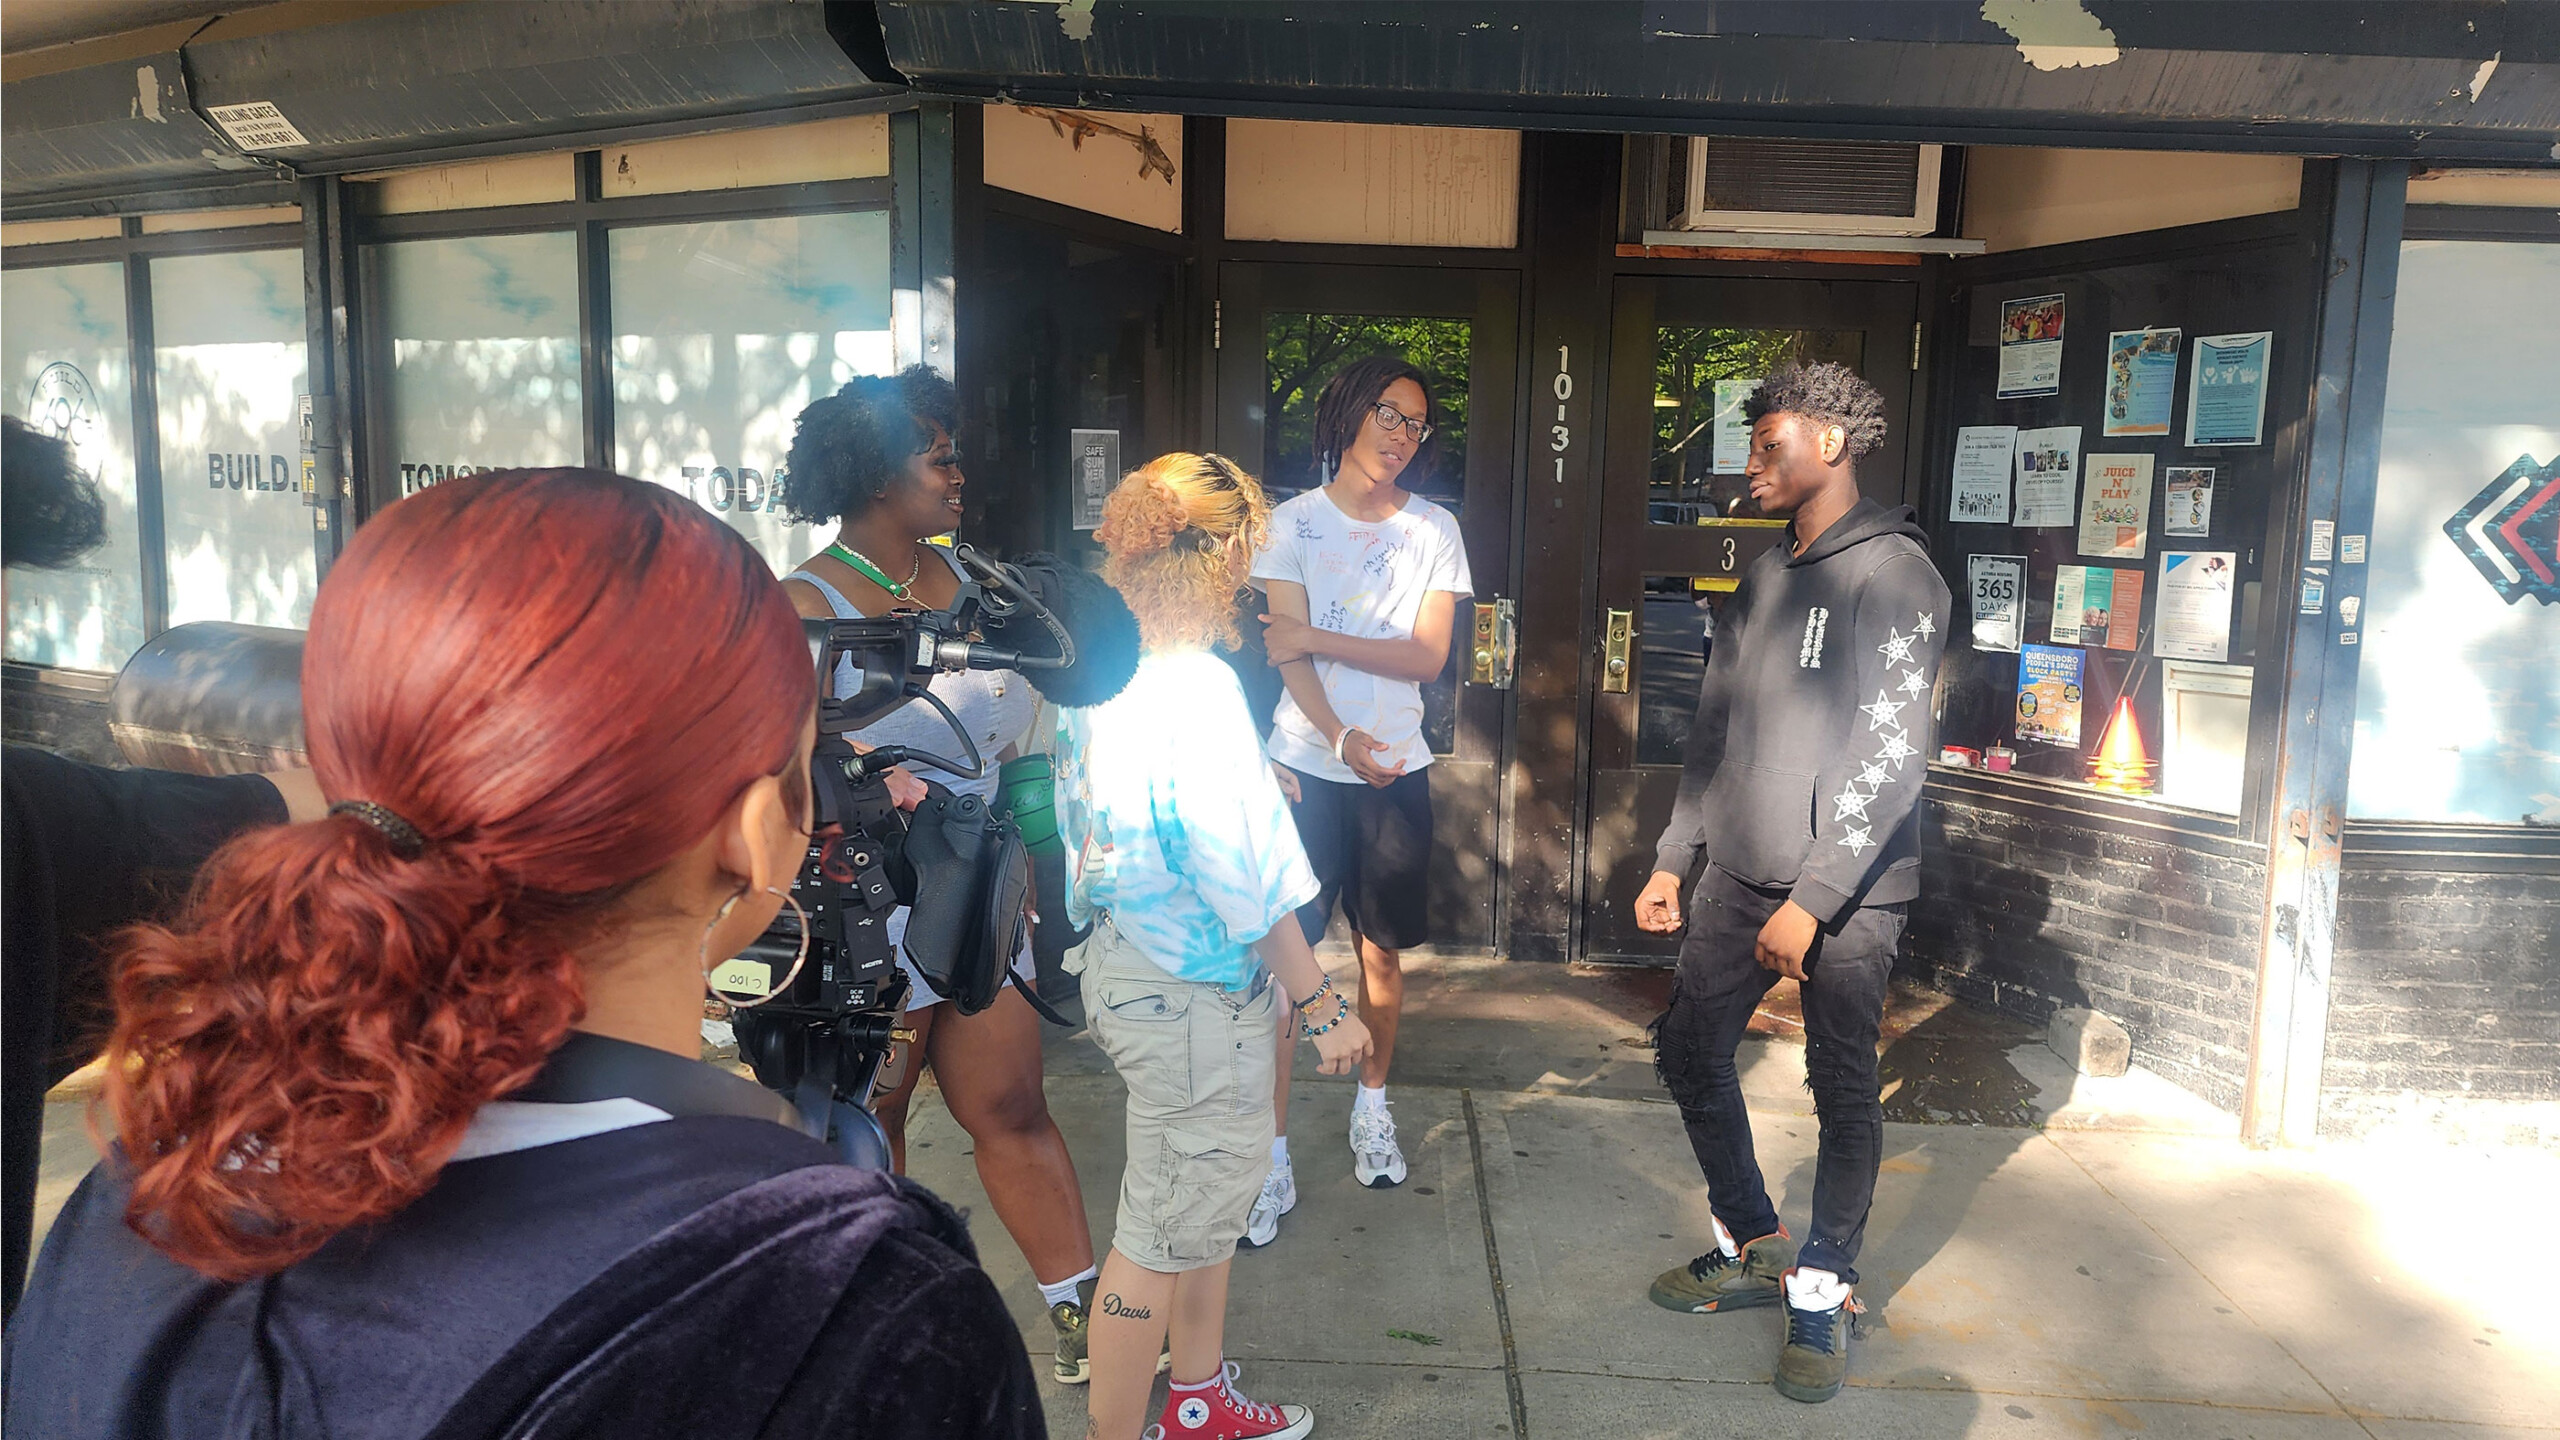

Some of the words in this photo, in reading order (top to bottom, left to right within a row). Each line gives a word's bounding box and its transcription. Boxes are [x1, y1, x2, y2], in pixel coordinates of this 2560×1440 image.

[213, 107, 251, 124] ROLLING
[248, 105, 280, 120] GATES
[1085, 446, 1105, 457] SAFE
[208, 453, 299, 493] BUILD.
[400, 463, 508, 493] TOMO
[2103, 467, 2136, 478] JUICE
[2101, 489, 2130, 499] PLAY
[1721, 537, 1736, 571] 3
[1977, 578, 2012, 600] 365
[1980, 601, 2008, 612] DAYS
[2025, 651, 2079, 664] QUEENSBORO
[2027, 667, 2049, 675] BLOCK
[2056, 662, 2078, 671] SPACE
[861, 959, 883, 969] HDMI
[1103, 1293, 1152, 1320] Davis
